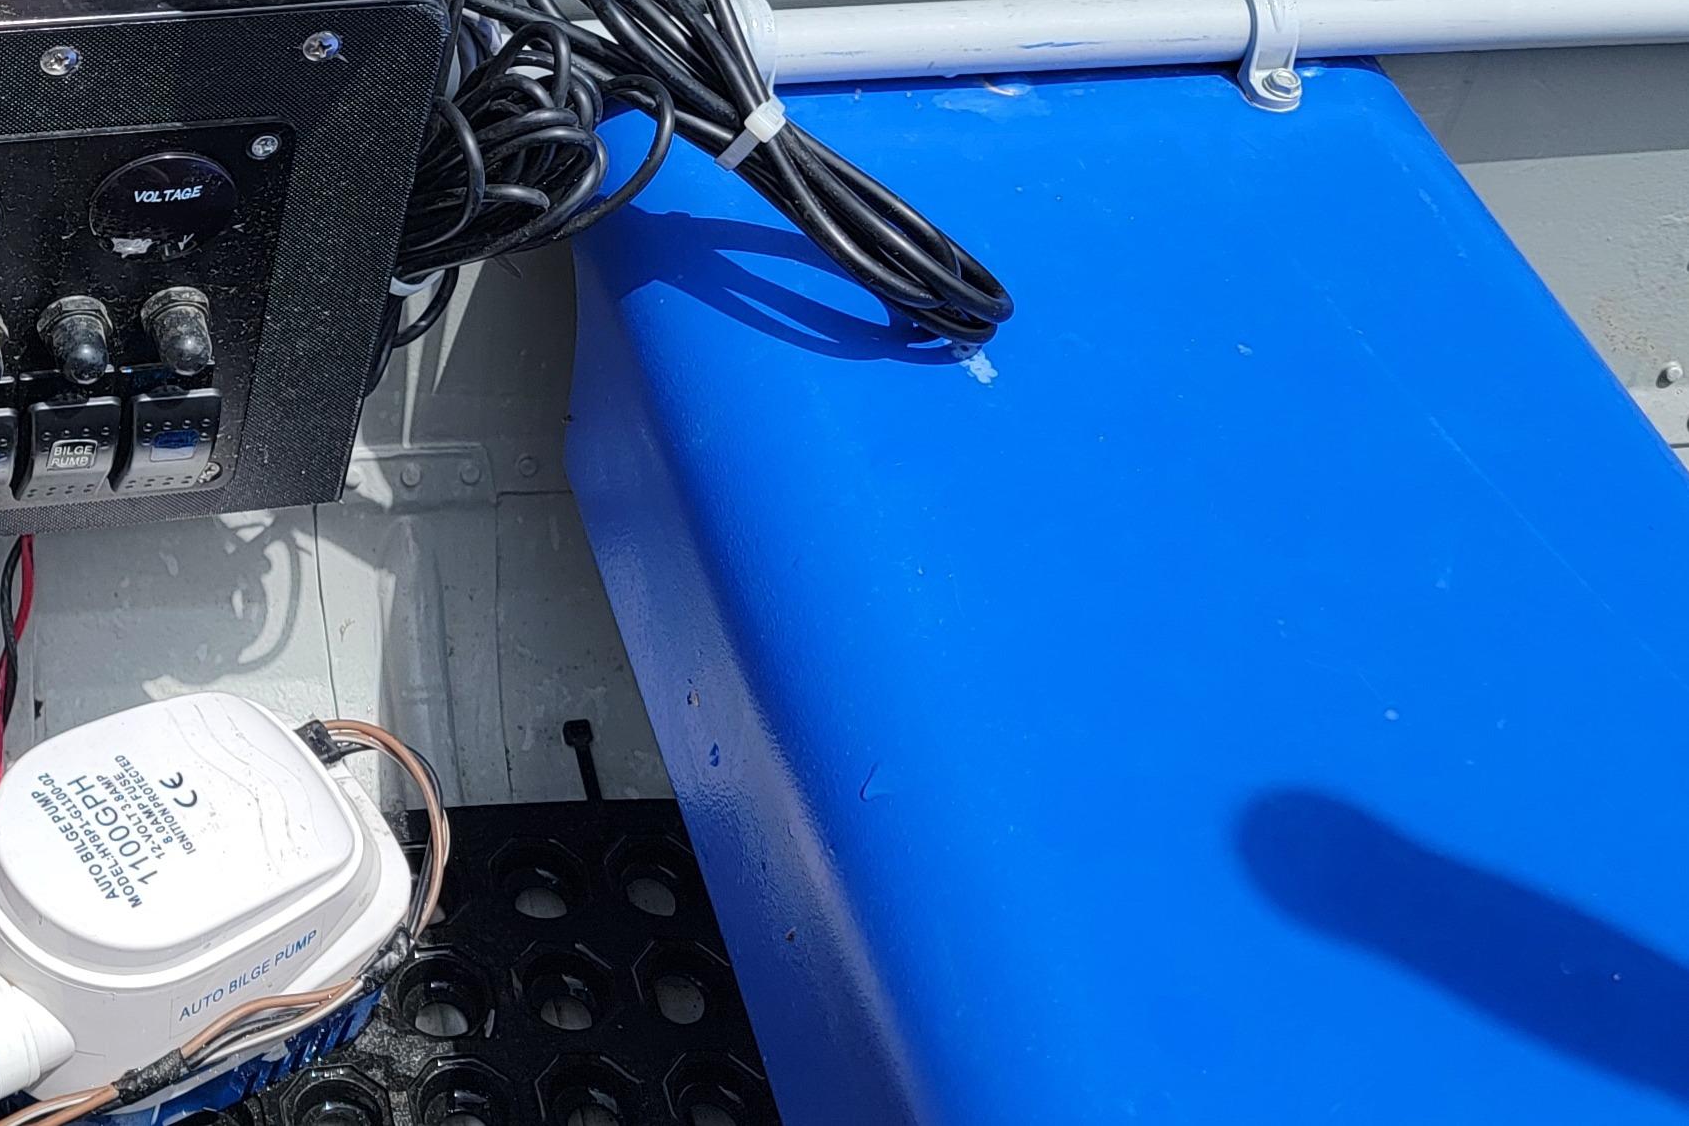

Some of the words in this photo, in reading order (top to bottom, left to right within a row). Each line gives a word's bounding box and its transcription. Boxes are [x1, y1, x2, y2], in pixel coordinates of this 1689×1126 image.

[133, 185, 203, 203] VOLTAGE
[54, 445, 94, 456] BILGE
[96, 775, 132, 812] 3.8AMP
[113, 772, 142, 802] FUSE
[114, 755, 164, 809] PROTECTED
[31, 791, 66, 824] PUMP
[137, 803, 174, 844] 8.0AMP
[58, 822, 96, 864] BILGE
[67, 775, 158, 885] 1100GPH
[125, 813, 166, 860] 12-VOLT
[158, 807, 197, 855] IGNITION
[88, 864, 120, 900] AUTO
[179, 988, 224, 1022] AUTO
[228, 959, 271, 995] BILGE
[274, 929, 317, 966] PUMP
